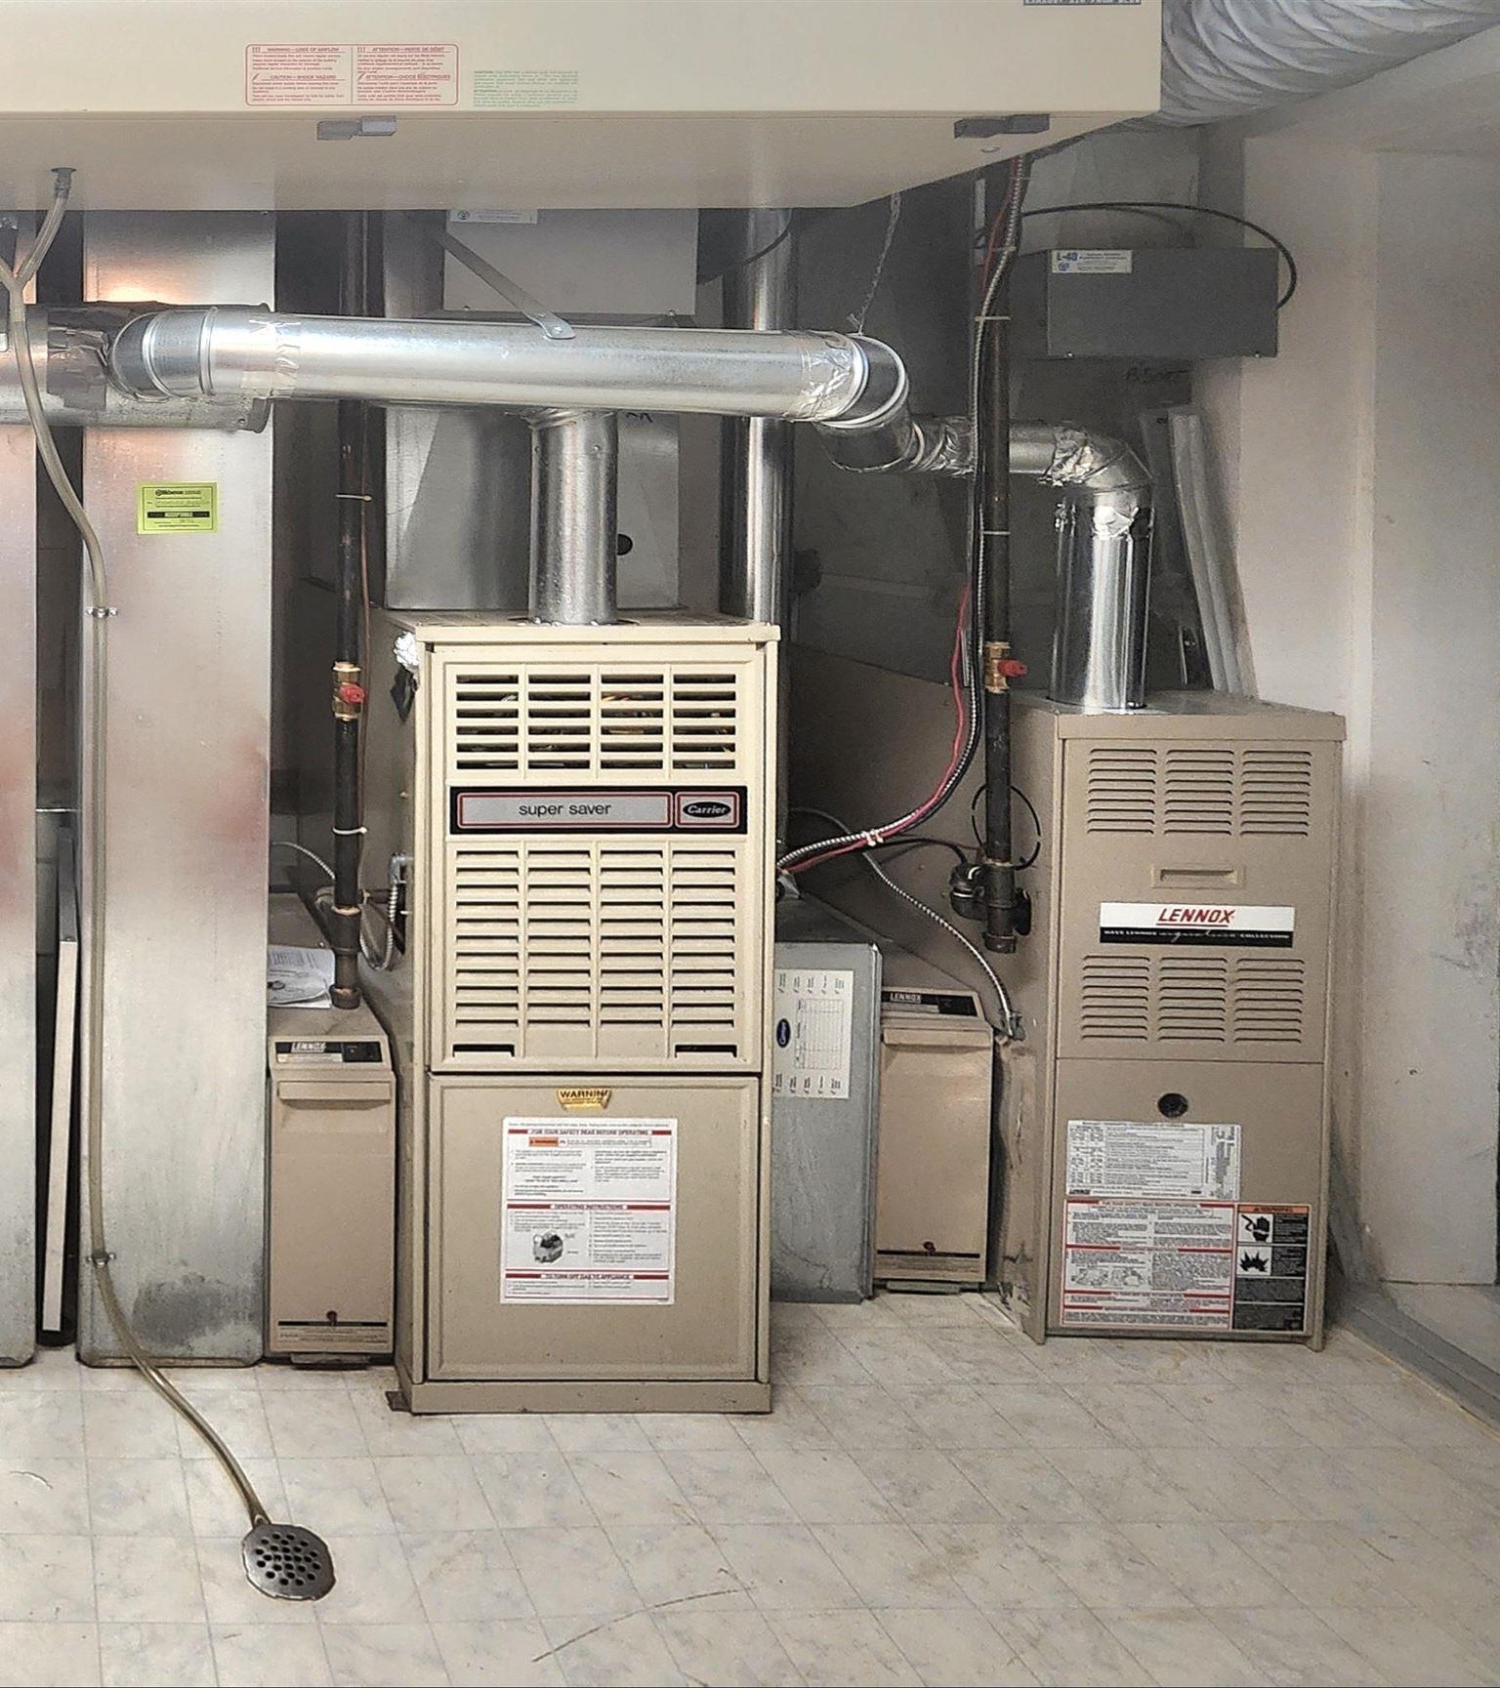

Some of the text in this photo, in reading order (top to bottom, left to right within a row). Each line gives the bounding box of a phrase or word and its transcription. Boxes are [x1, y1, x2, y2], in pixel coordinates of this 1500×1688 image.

[518, 803, 612, 817] super saver
[687, 804, 728, 816] Carrier
[1158, 908, 1236, 924] LENNOX
[560, 1089, 609, 1099] WARNIN
